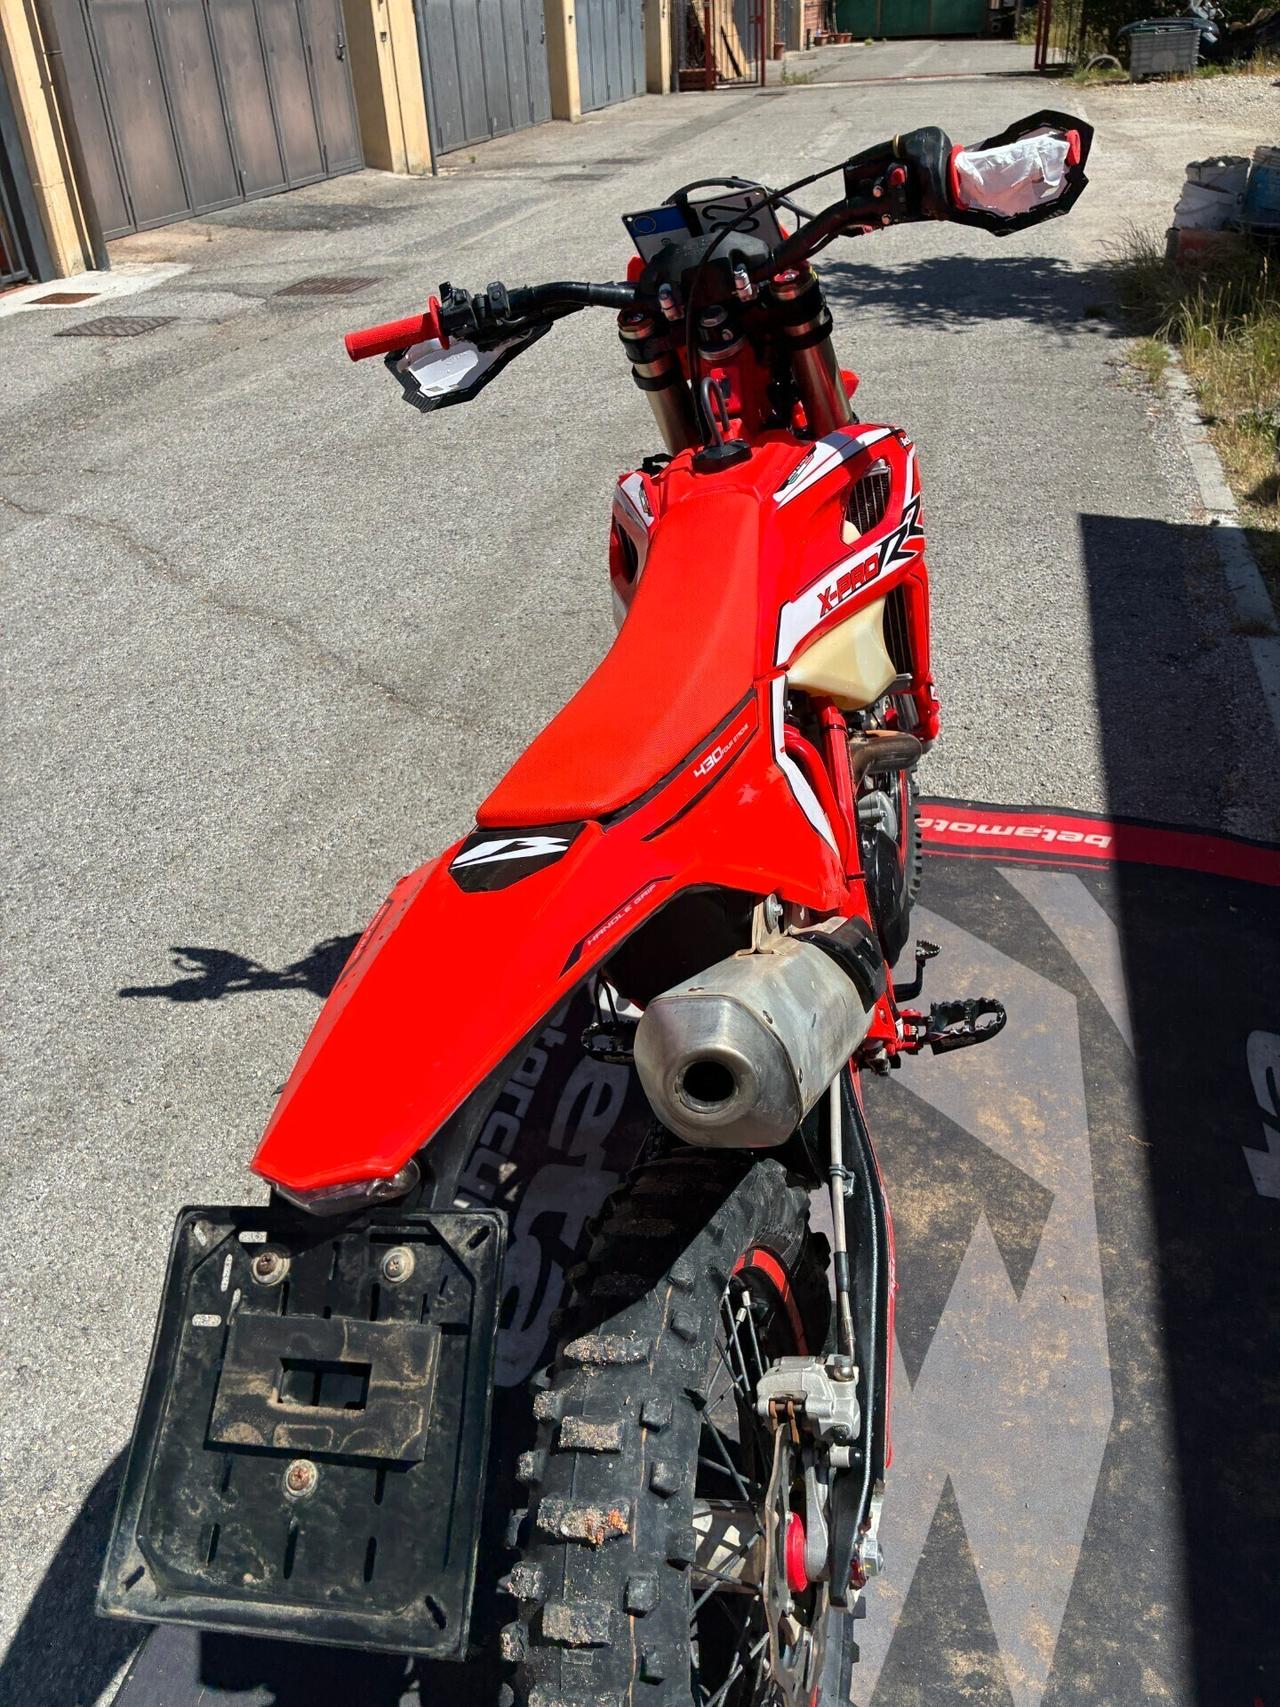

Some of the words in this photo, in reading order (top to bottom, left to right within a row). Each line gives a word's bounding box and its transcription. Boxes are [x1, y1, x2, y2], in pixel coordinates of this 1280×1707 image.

[693, 746, 723, 778] 430
[587, 904, 633, 946] HANDLE
[633, 883, 657, 905] GRIP
